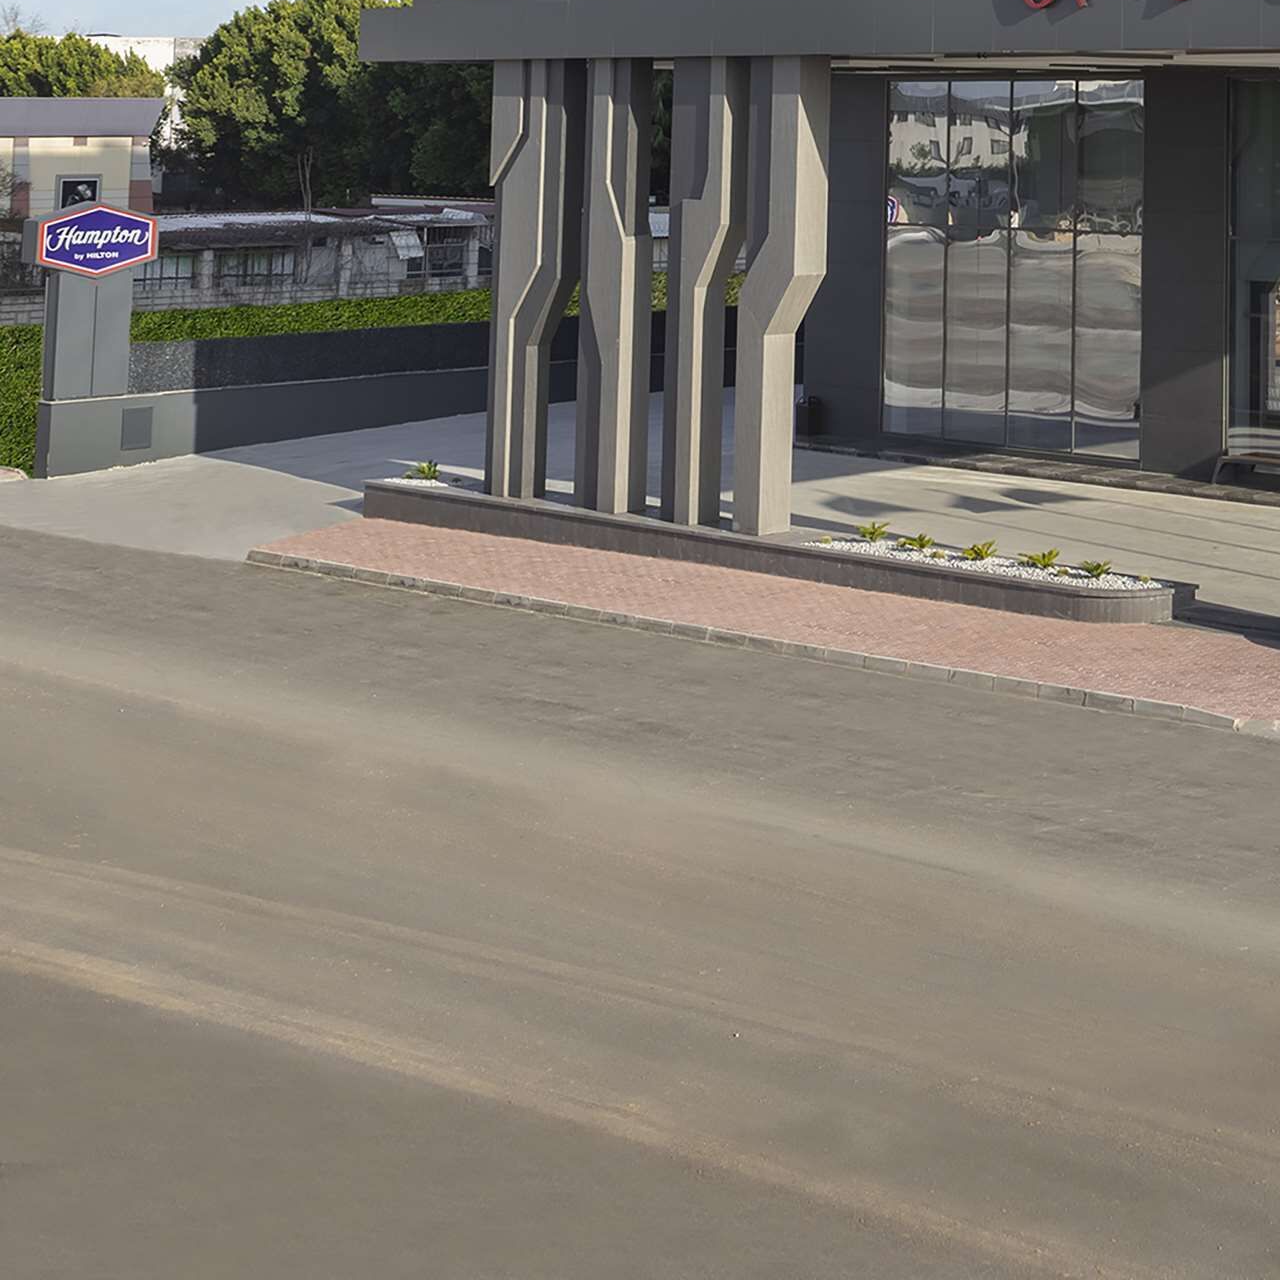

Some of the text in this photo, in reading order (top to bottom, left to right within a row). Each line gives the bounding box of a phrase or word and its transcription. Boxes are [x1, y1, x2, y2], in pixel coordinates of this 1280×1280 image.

[46, 225, 149, 252] Hampton
[73, 251, 120, 261] by HILTON
